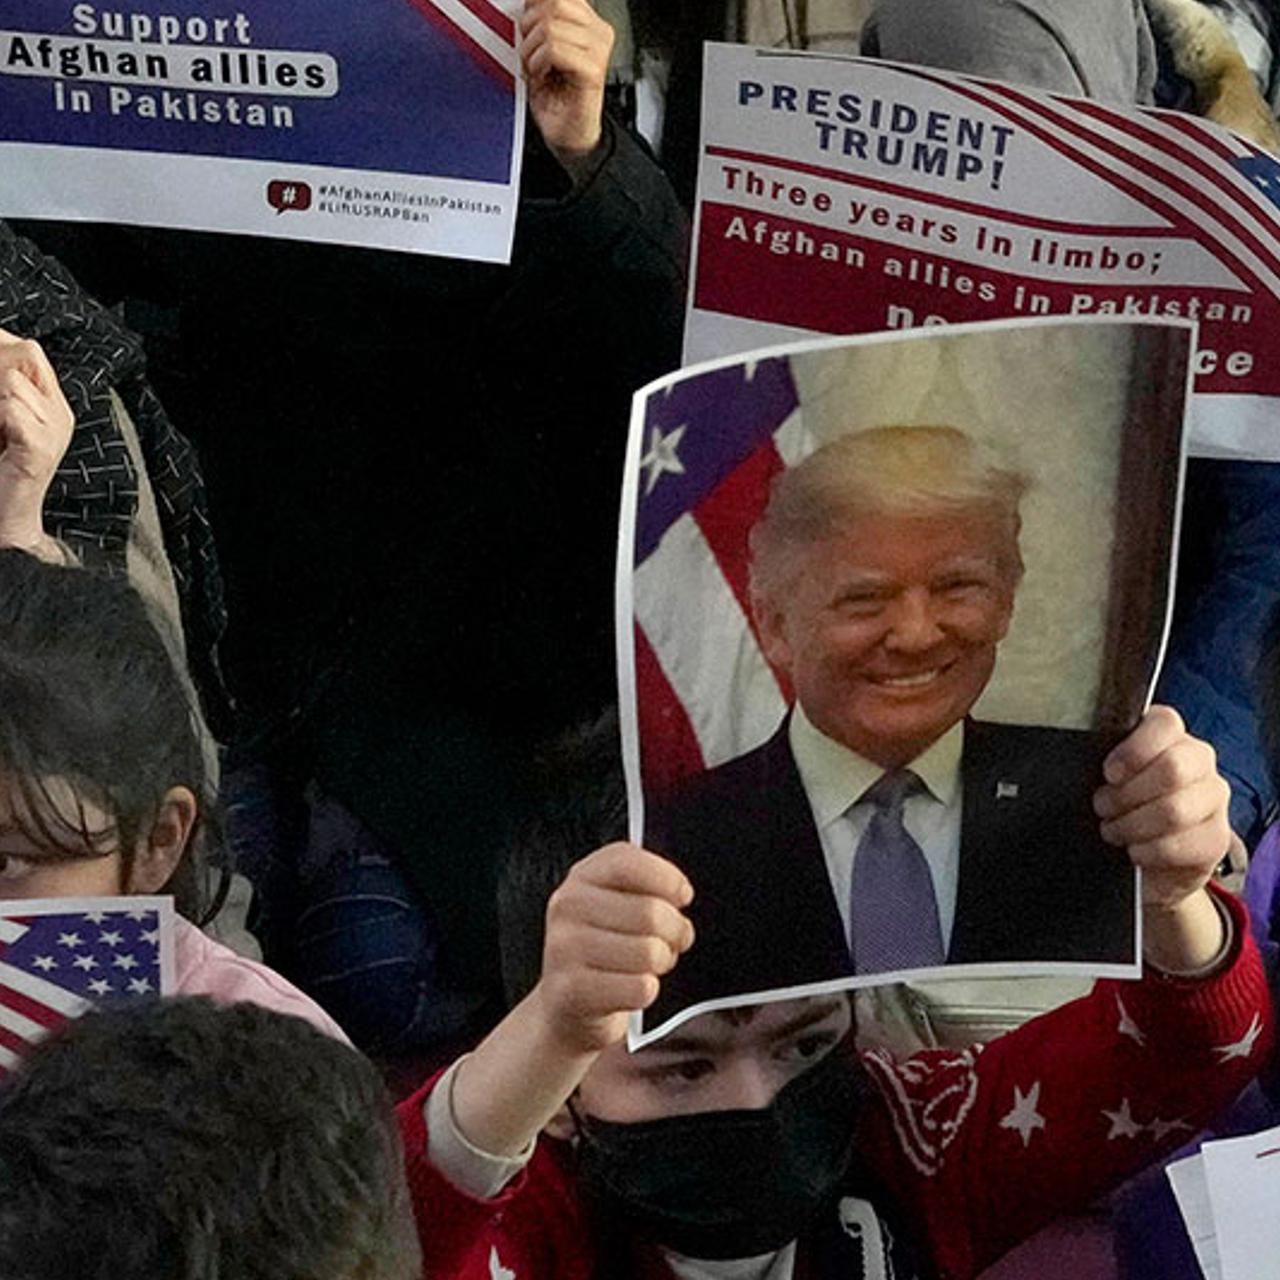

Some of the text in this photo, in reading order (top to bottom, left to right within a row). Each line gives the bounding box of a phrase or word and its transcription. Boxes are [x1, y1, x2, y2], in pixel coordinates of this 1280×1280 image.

[74, 4, 250, 44] Support
[8, 37, 325, 88] Afghan allies
[110, 87, 292, 127] Pakistan
[738, 81, 1013, 157] PRESIDENT
[816, 121, 1004, 190] TRUMP!
